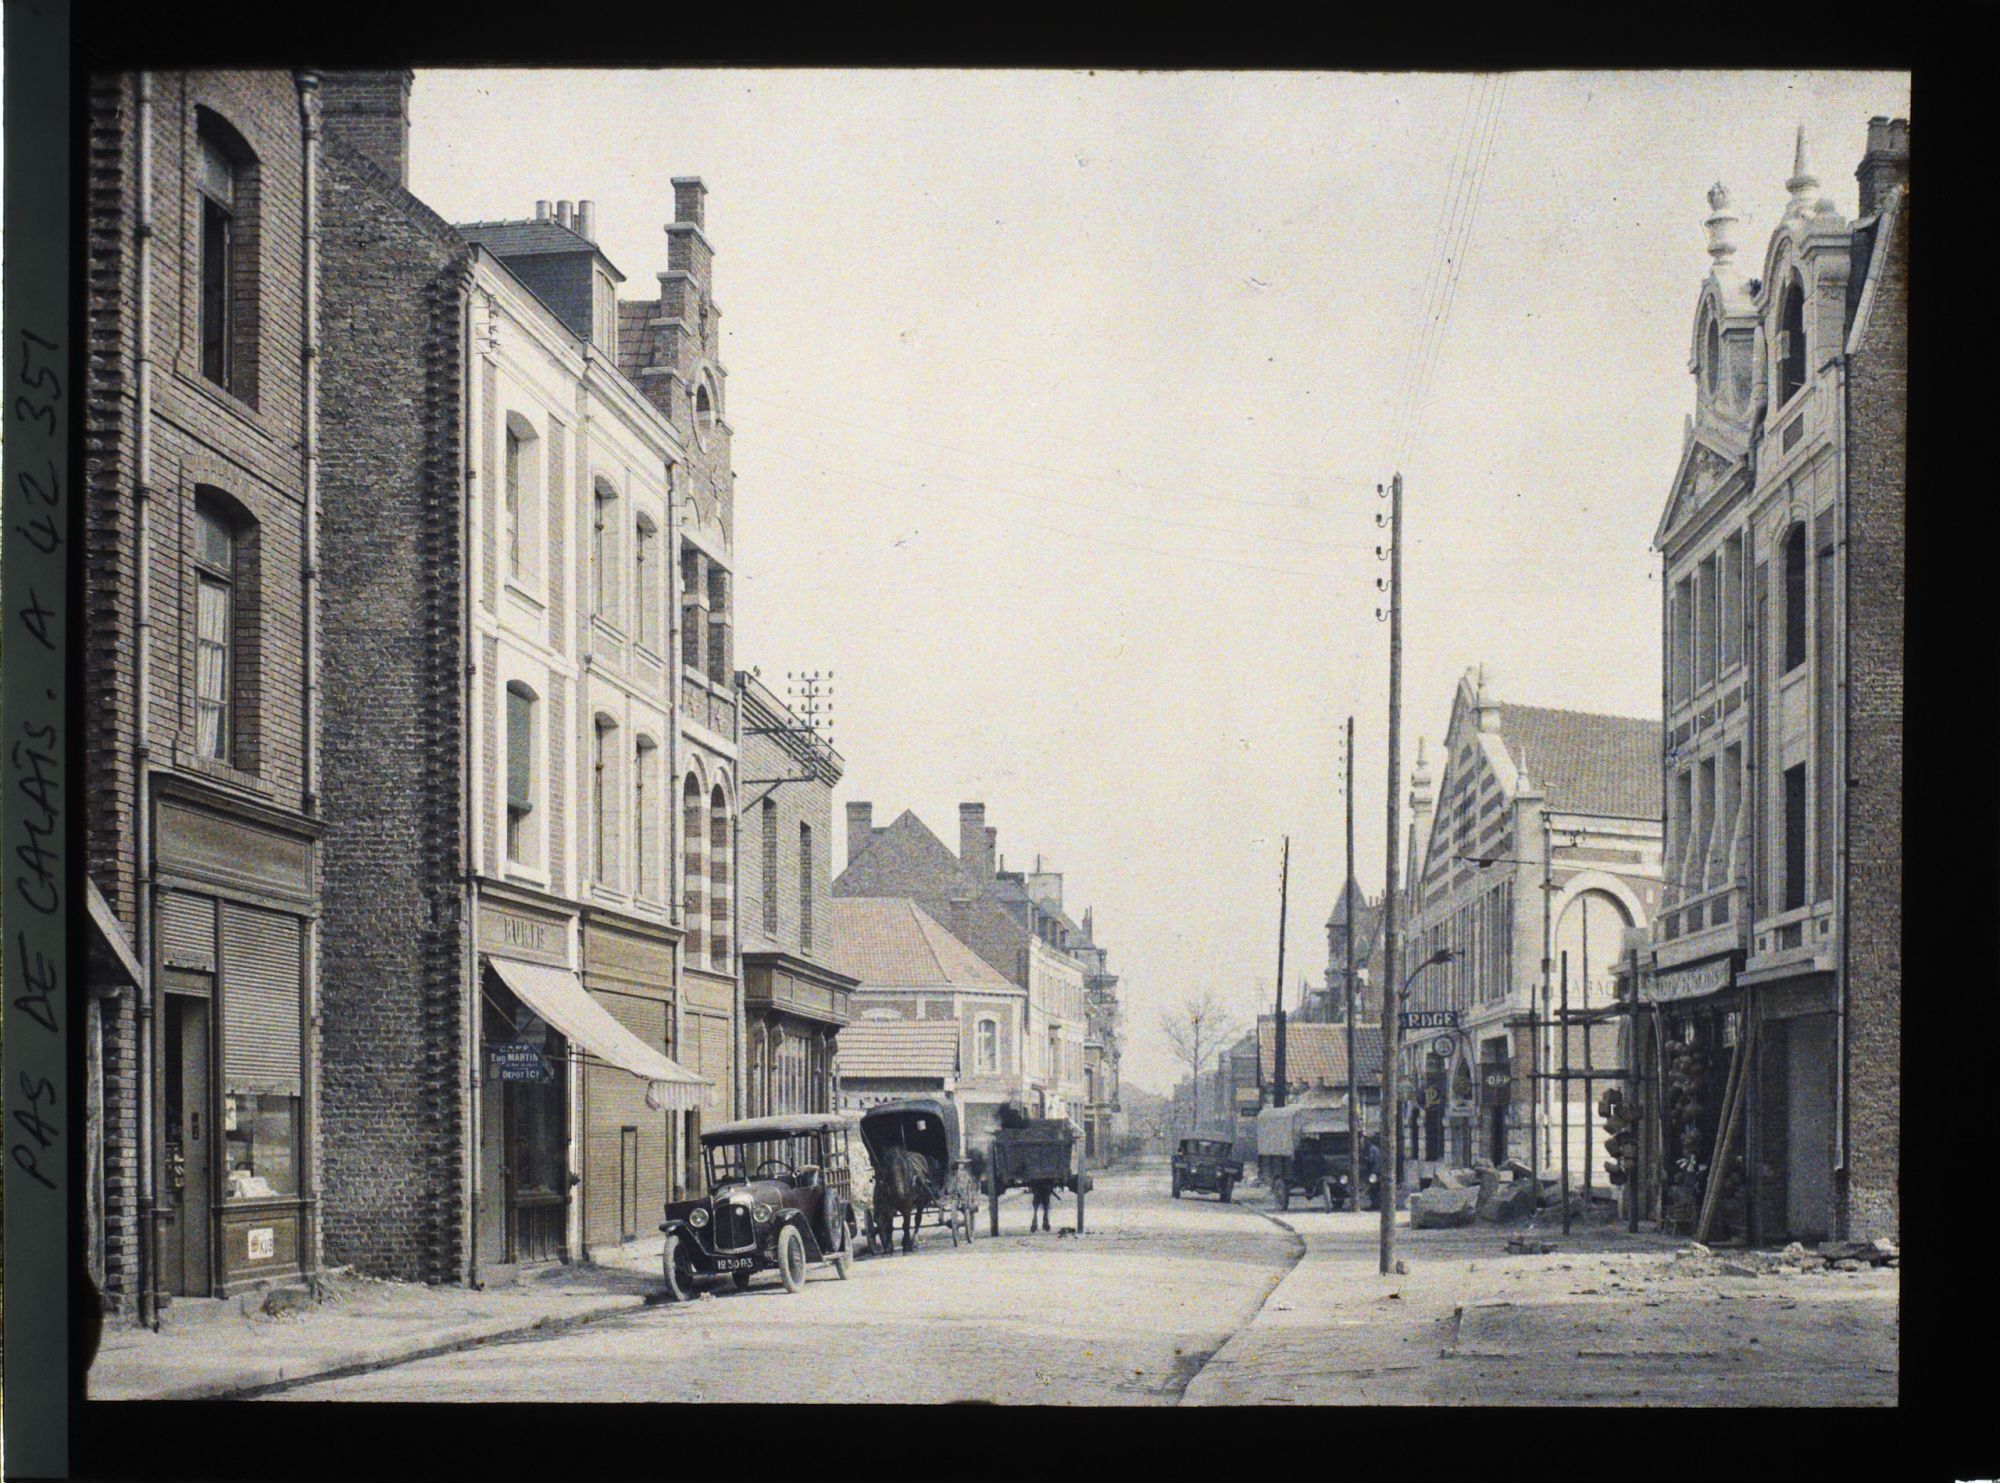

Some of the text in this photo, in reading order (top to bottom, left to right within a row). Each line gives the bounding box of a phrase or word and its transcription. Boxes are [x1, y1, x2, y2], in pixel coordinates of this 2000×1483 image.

[19, 586, 56, 651] A
[14, 930, 59, 1033] DE
[507, 1053, 539, 1062] MARTIN
[12, 1070, 60, 1190] PAS
